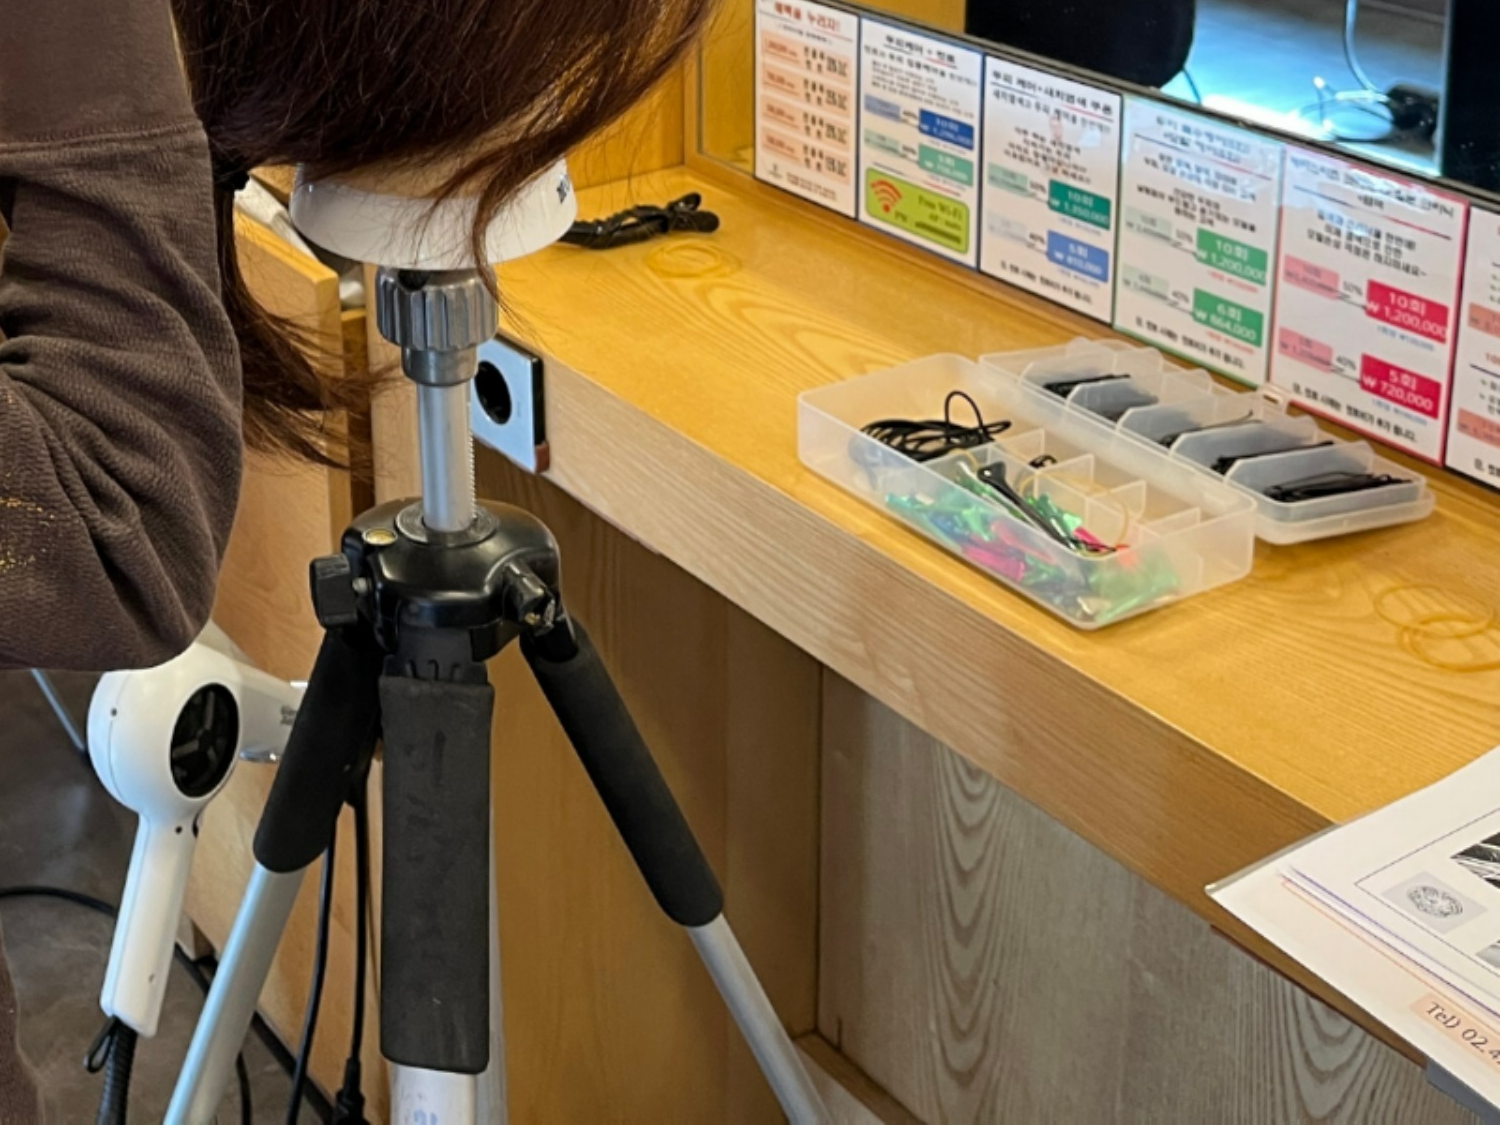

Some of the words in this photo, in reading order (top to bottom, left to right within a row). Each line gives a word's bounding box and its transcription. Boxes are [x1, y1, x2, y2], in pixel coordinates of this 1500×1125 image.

[1215, 238, 1248, 261] 10회
[1210, 252, 1266, 282] 1,200,000
[1342, 280, 1362, 297] 50%
[1388, 290, 1426, 316] 10회
[1209, 312, 1256, 341] 864,000
[1383, 305, 1448, 340] 1,200,000
[1335, 353, 1356, 371] 40%
[1388, 368, 1417, 391] 5회
[1379, 379, 1432, 412] 720,000
[1461, 1028, 1500, 1065] 02.4
